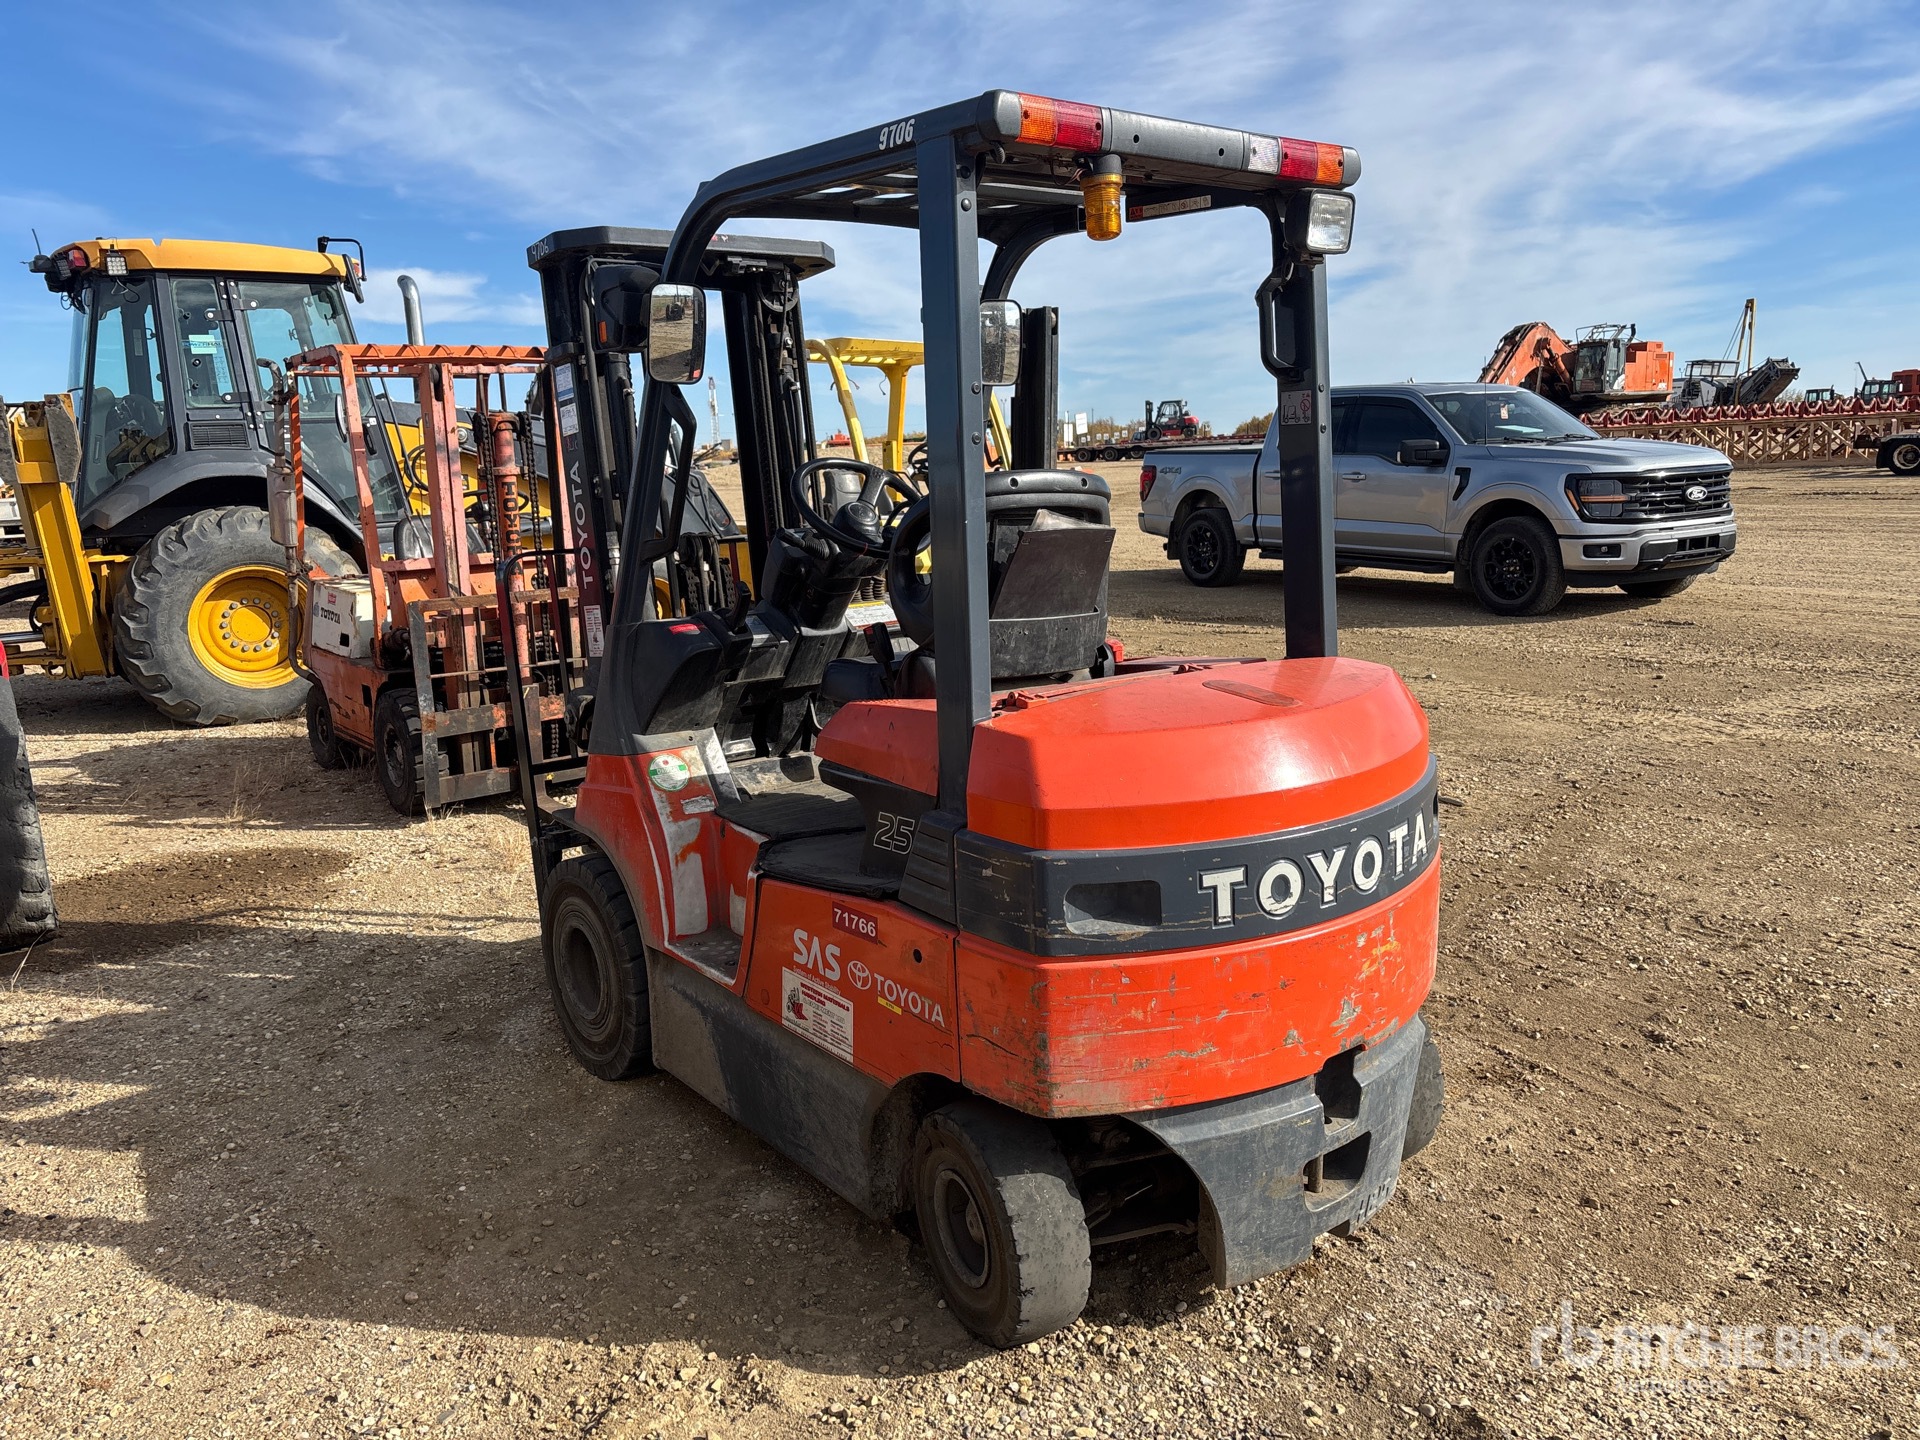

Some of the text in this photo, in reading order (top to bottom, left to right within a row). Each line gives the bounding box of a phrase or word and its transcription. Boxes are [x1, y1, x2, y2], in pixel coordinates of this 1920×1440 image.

[879, 118, 916, 151] 9706
[569, 460, 593, 590] TOYOTA
[320, 606, 341, 625] TOYOTA
[873, 811, 916, 855] 25
[1199, 810, 1429, 927] TOYOTA
[833, 908, 877, 938] 71766
[793, 928, 841, 981] SAS
[873, 972, 945, 1027] TOYOTA
